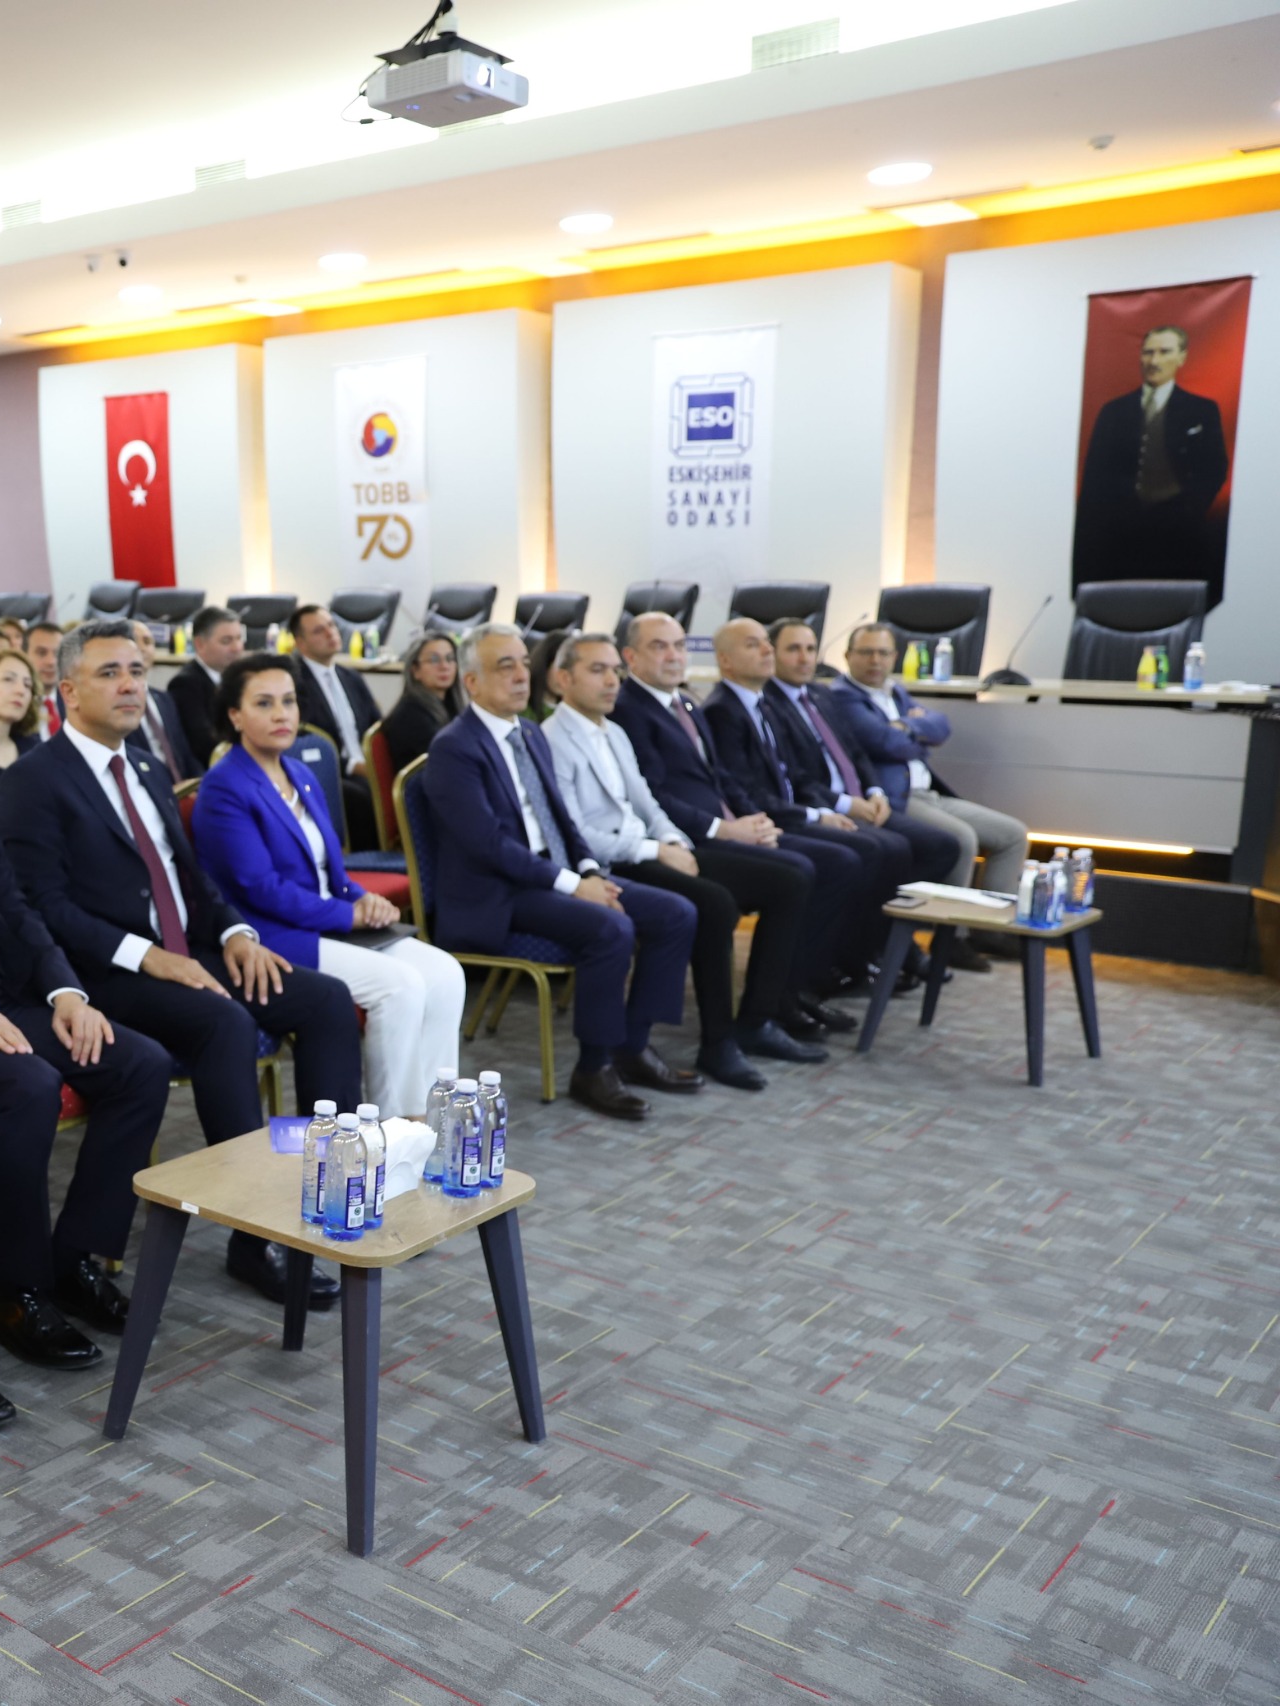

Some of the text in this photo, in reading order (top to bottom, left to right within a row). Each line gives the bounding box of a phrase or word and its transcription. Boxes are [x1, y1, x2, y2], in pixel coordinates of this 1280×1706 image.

[687, 405, 734, 428] ESO
[352, 481, 410, 505] TOBB
[667, 510, 750, 528] ODASI
[357, 514, 414, 561] 70
